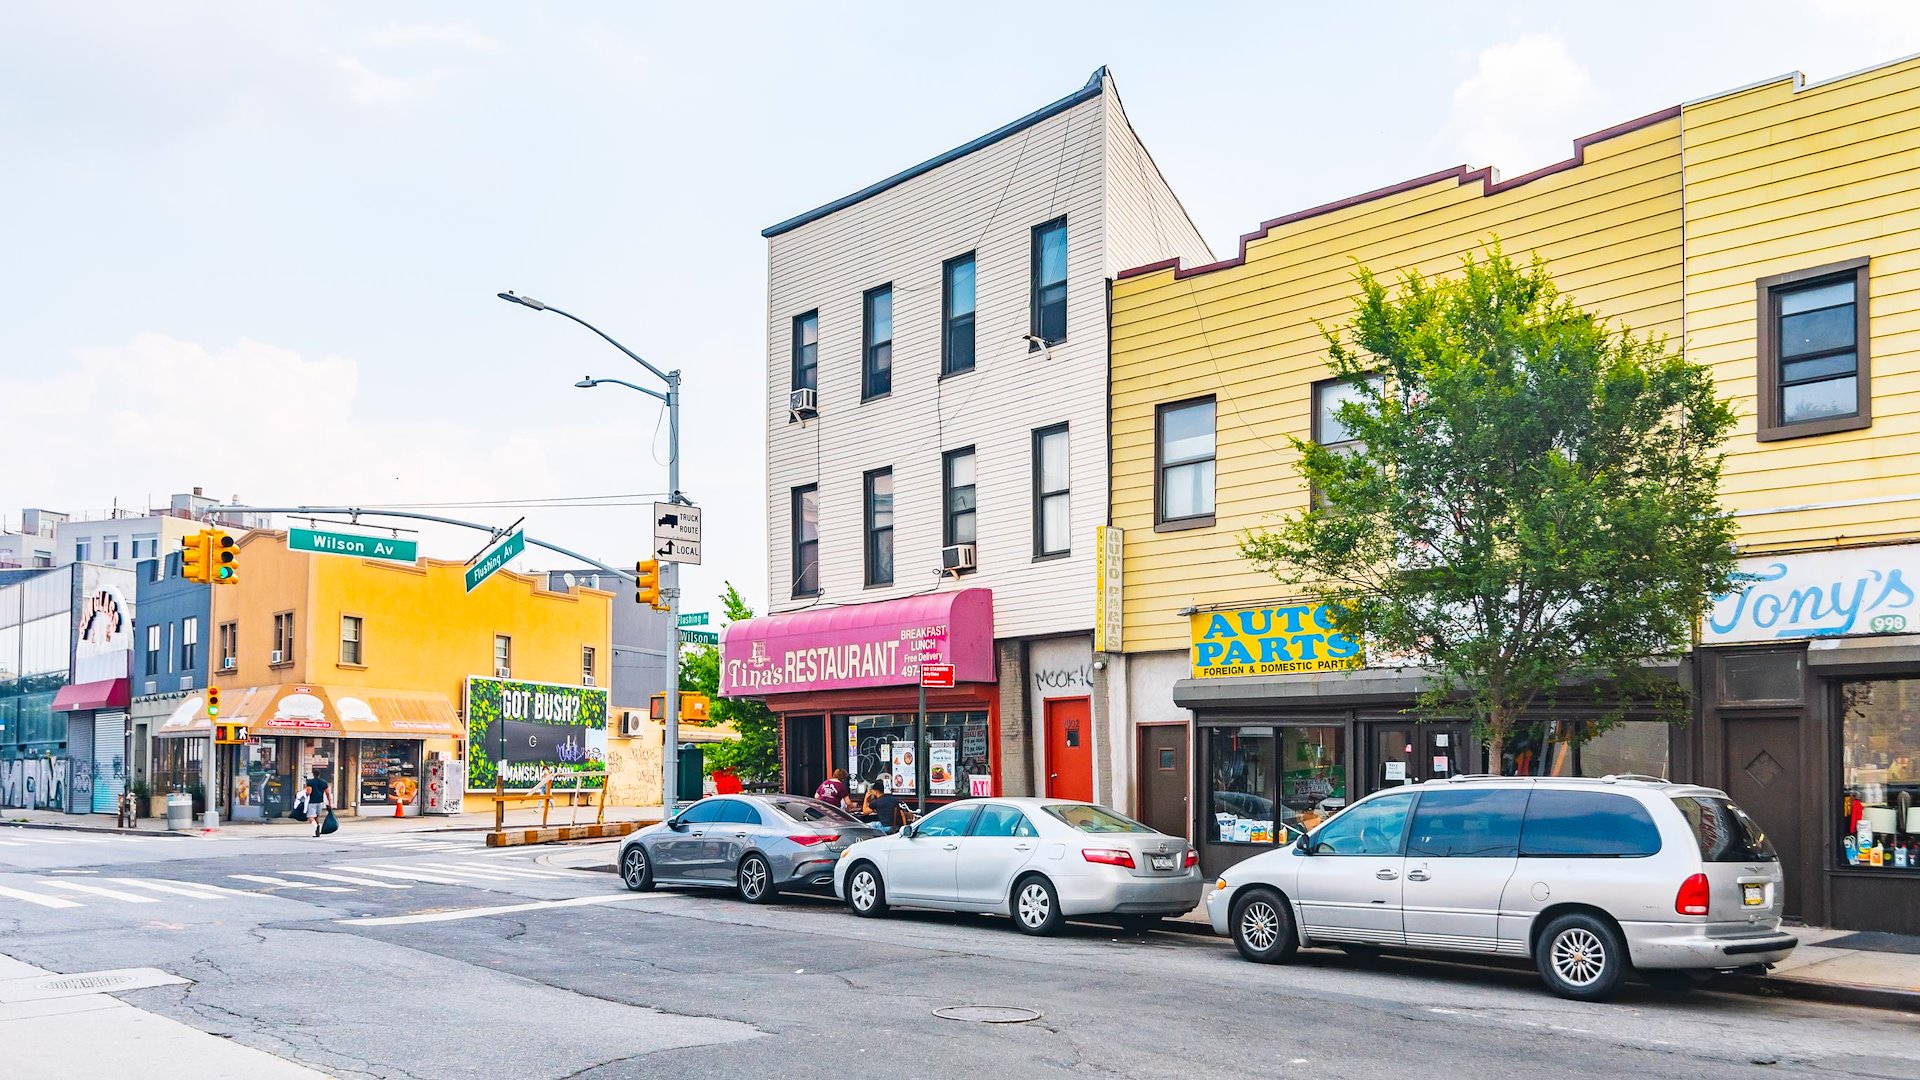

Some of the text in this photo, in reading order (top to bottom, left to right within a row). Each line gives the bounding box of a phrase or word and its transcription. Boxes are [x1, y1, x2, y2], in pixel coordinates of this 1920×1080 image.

[680, 513, 699, 523] TRUCK
[679, 525, 699, 535] ROUTE
[313, 534, 394, 555] Wilson Av
[676, 545, 699, 556] LOCAL
[474, 544, 513, 582] Flushing Av
[1710, 562, 1915, 638] Tony's
[678, 613, 702, 626] Flushing
[1203, 603, 1349, 640] AUTO
[1874, 617, 1904, 632] 998
[681, 630, 709, 644] Wilson
[901, 625, 947, 640] BREAKFAST
[911, 638, 936, 652] LUNCH
[1195, 632, 1360, 667] PARTS
[727, 658, 784, 690] Tina's
[784, 639, 900, 684] RESTAURANT
[904, 651, 943, 663] Free Delivery
[1203, 665, 1245, 676] FOREIGN
[1249, 665, 1256, 674] &
[1261, 661, 1313, 673] DOMESTIC
[502, 690, 580, 722] GOT BUSH?
